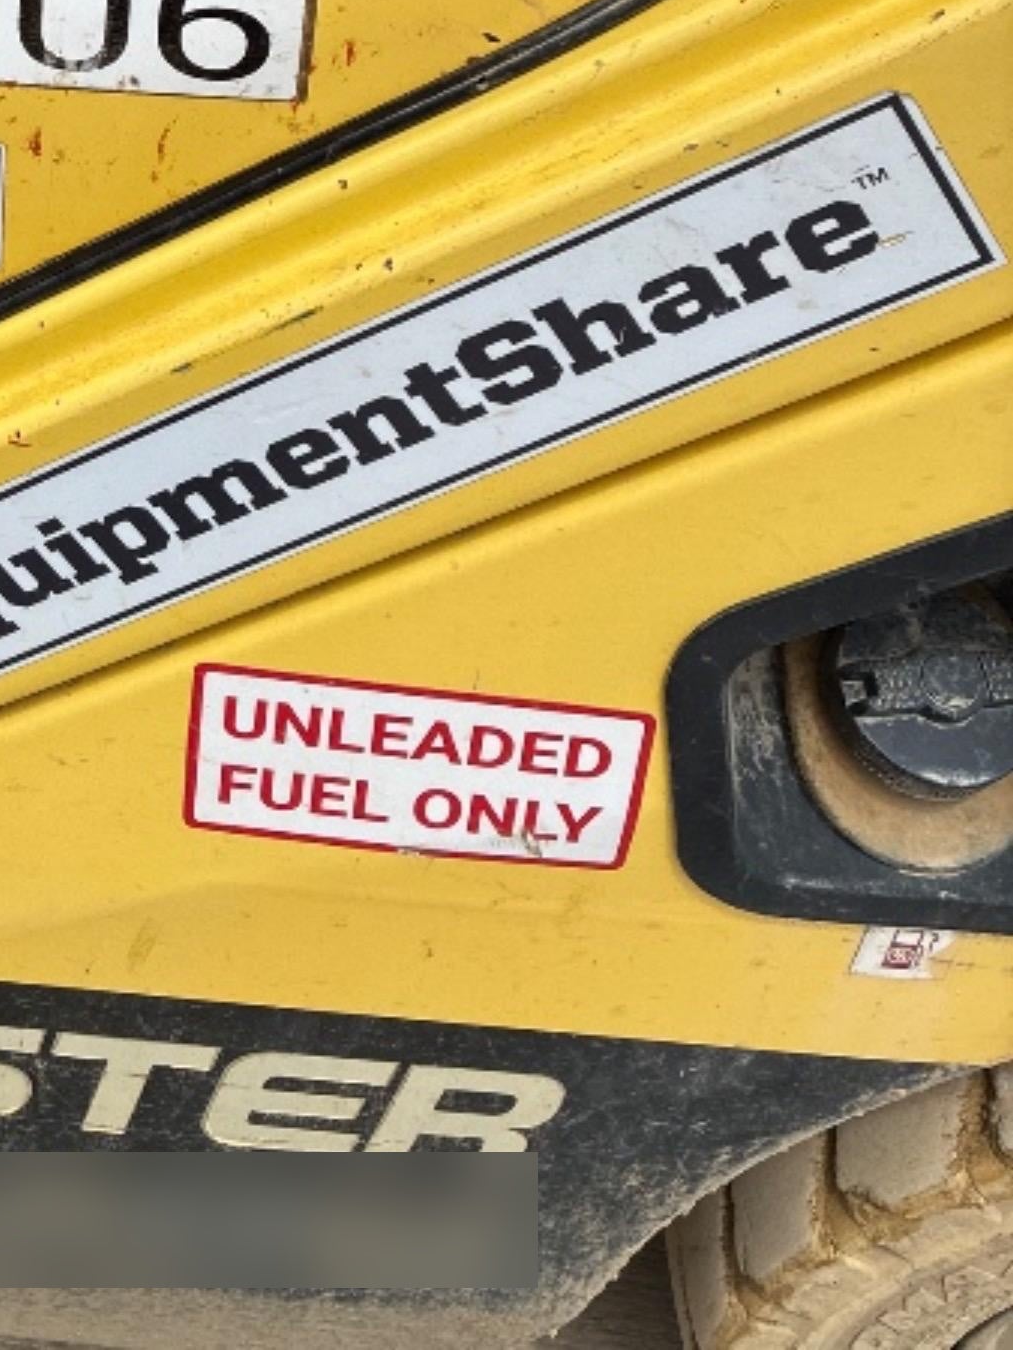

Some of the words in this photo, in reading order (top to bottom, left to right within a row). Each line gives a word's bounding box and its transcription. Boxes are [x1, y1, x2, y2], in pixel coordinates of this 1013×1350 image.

[223, 695, 613, 779] UNLEADED
[217, 763, 389, 823] FUEL
[413, 787, 604, 844] ONLY
